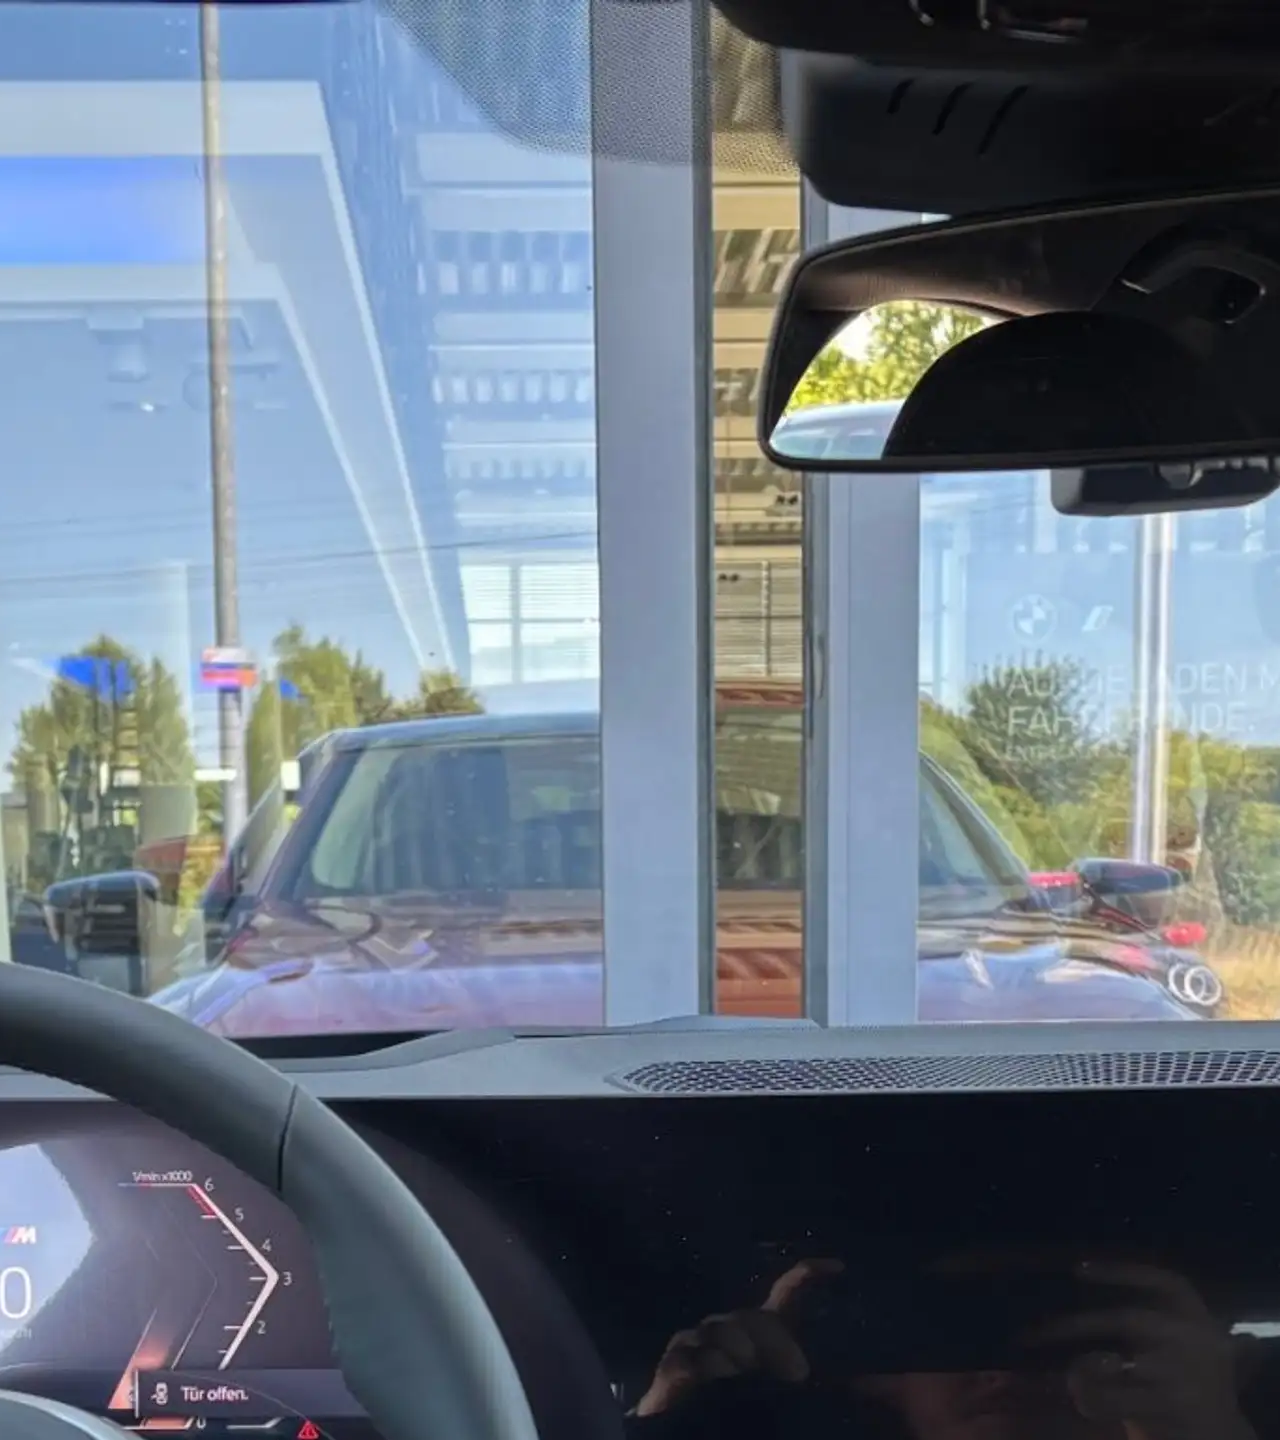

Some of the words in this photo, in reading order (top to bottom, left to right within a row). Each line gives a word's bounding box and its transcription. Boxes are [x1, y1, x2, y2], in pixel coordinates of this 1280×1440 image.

[204, 1178, 215, 1192] 6
[235, 1208, 244, 1221] 5
[262, 1238, 272, 1251] 4
[283, 1272, 292, 1286] 3
[0, 1266, 32, 1319] 0
[257, 1321, 266, 1334] 2
[181, 1386, 204, 1401] Tür
[207, 1385, 249, 1401] offen.
